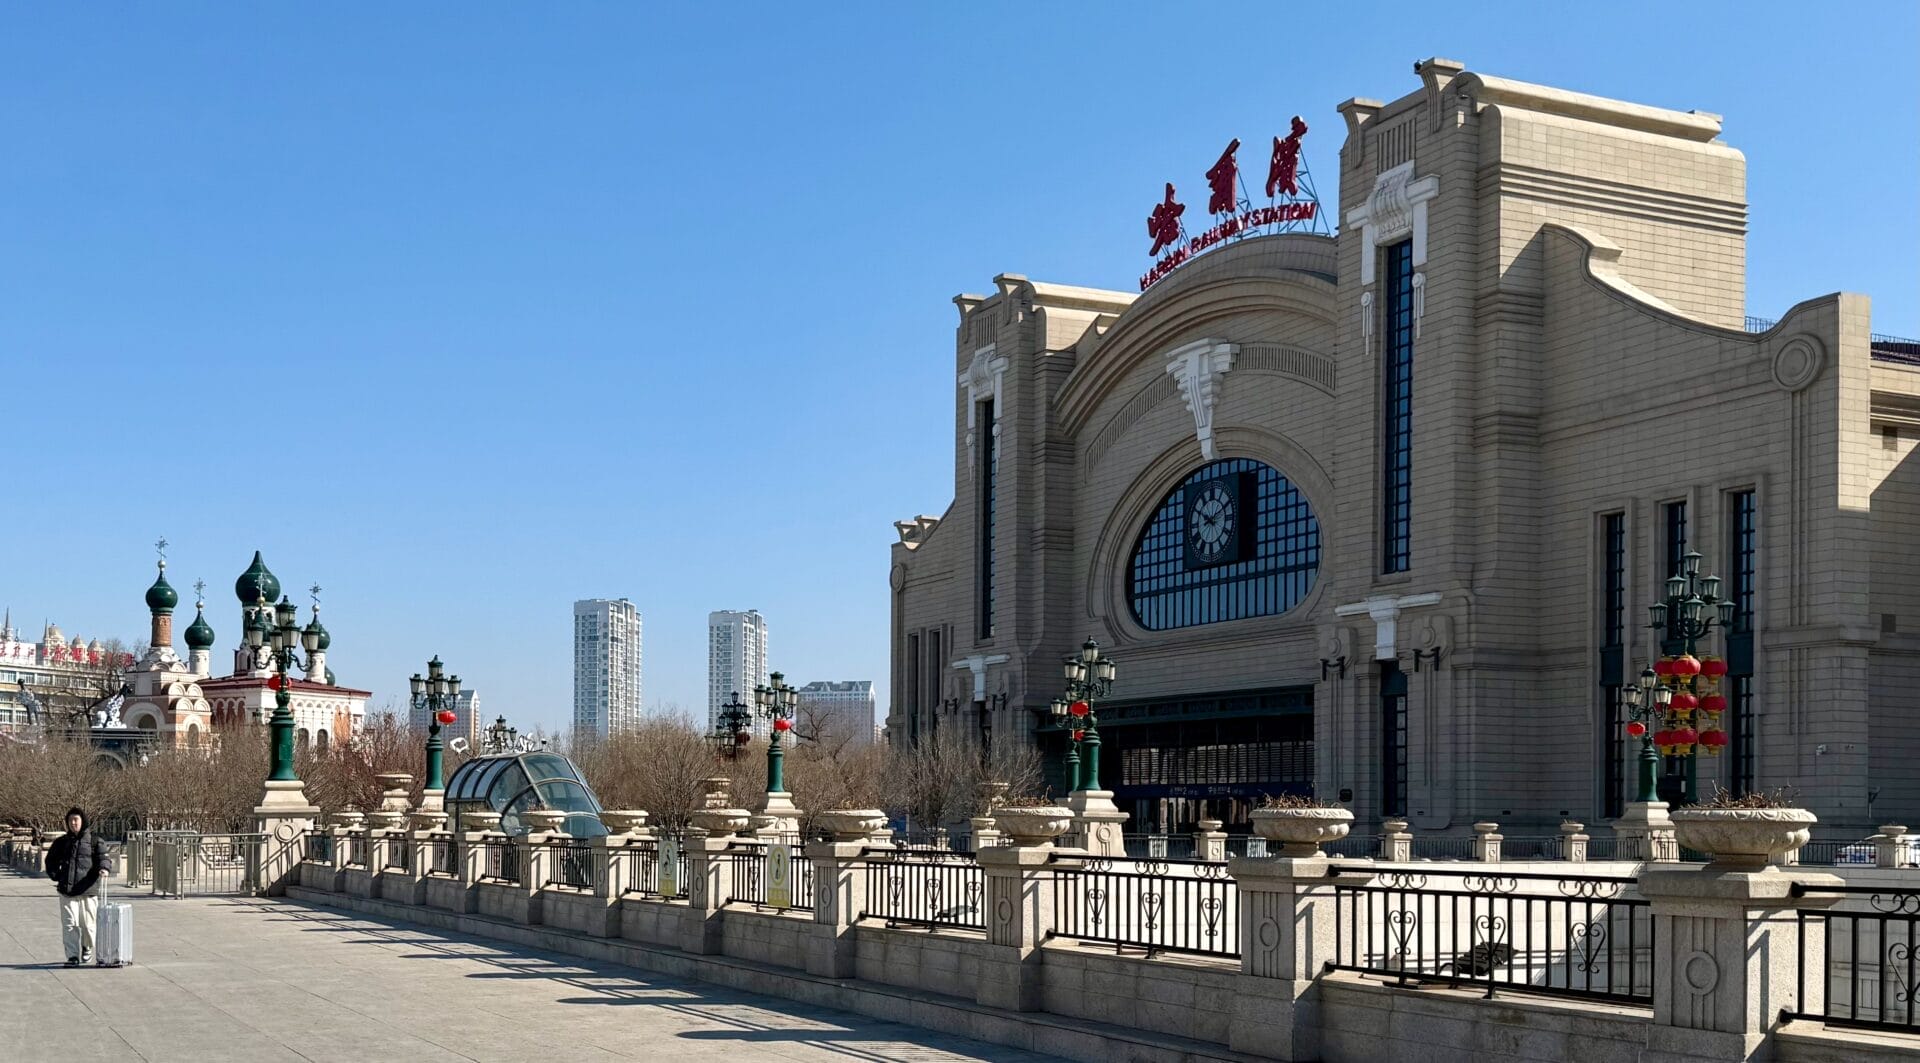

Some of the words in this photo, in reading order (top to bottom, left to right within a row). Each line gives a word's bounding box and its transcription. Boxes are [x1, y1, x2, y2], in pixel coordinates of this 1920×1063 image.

[1140, 245, 1189, 291] HARBIN
[1191, 211, 1251, 253] RAILWAY
[1251, 202, 1316, 226] STATION
